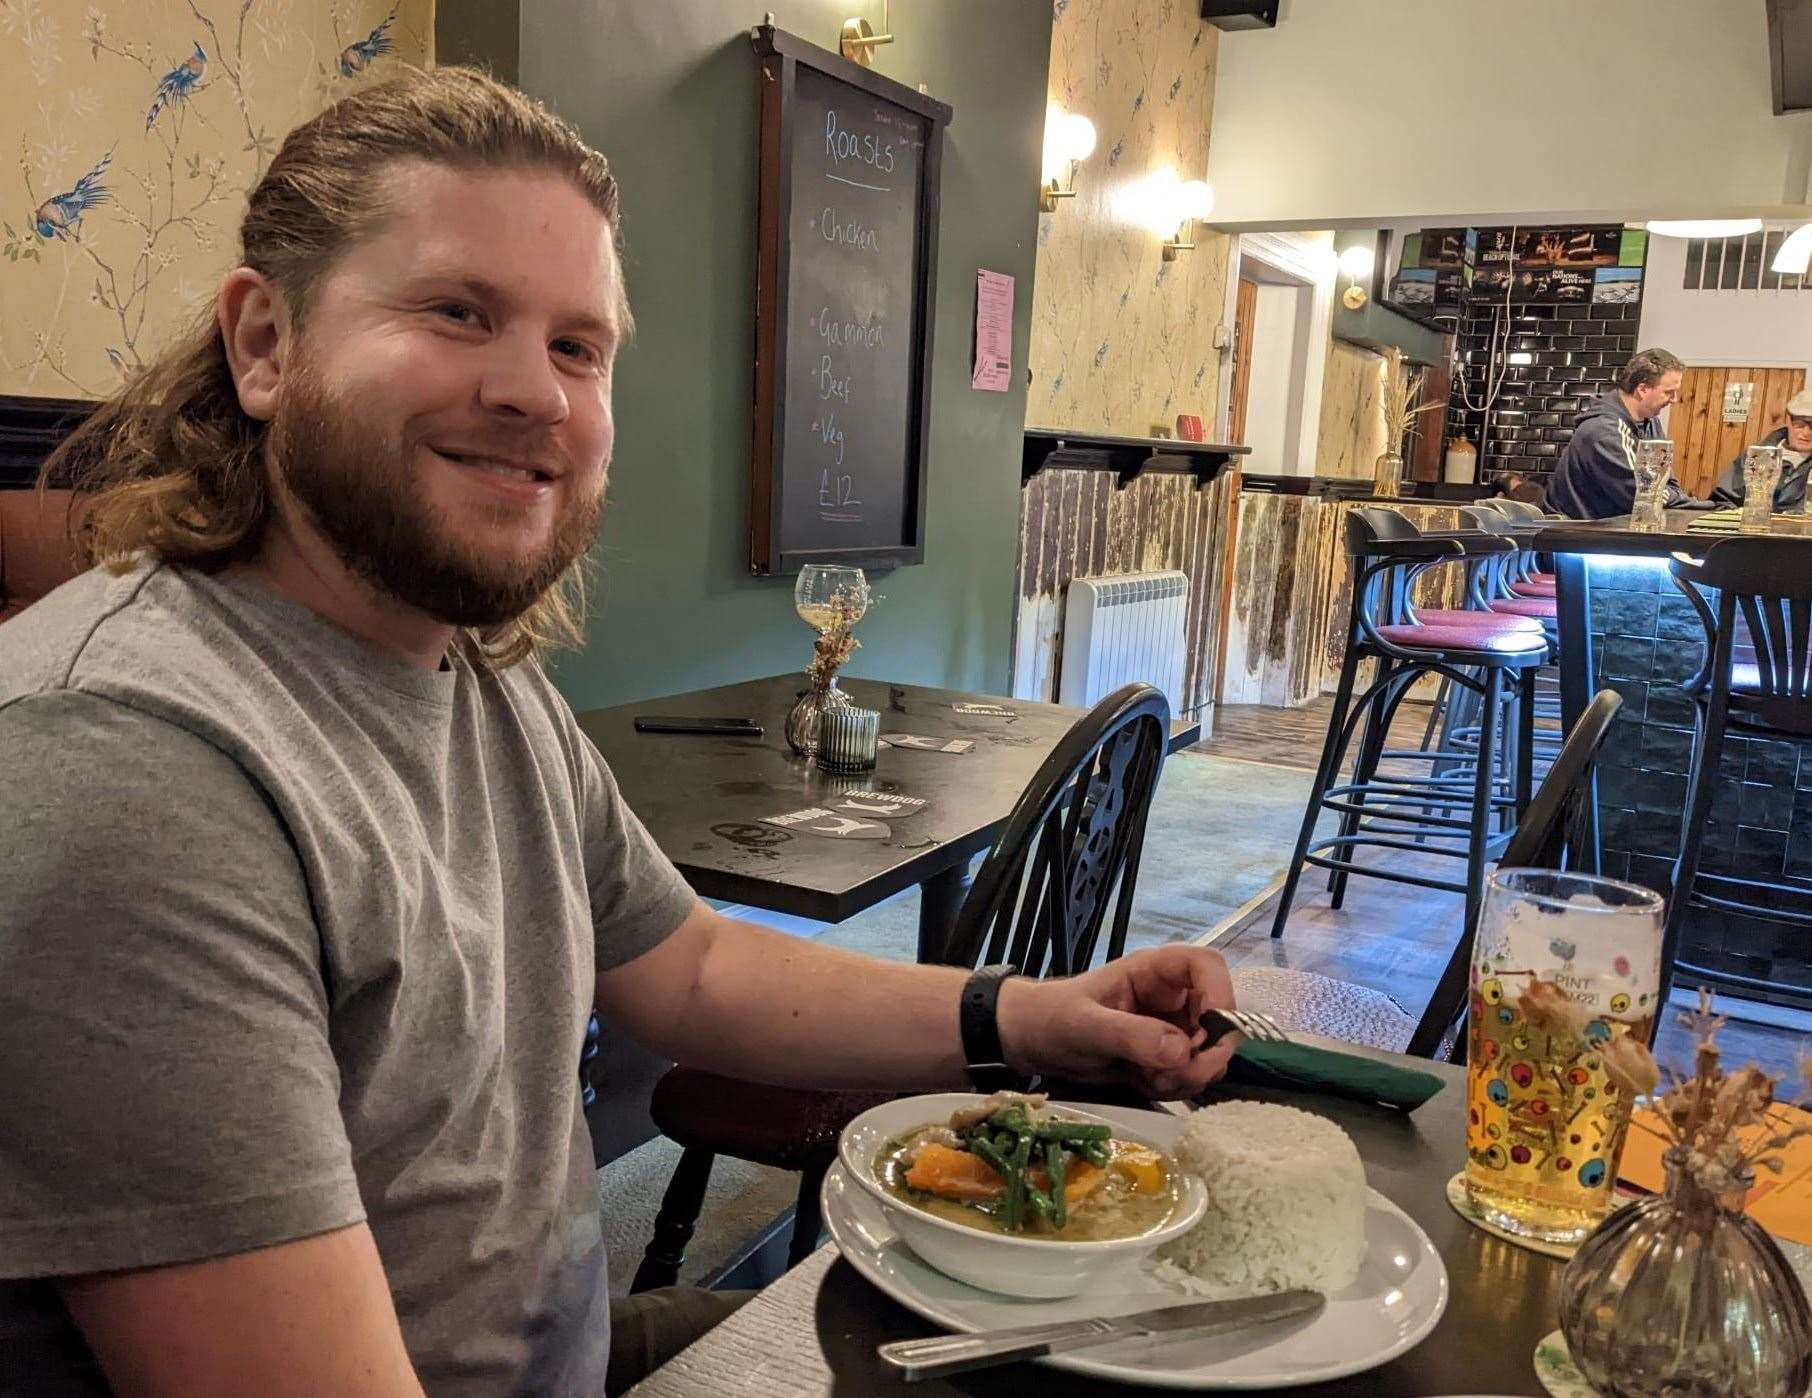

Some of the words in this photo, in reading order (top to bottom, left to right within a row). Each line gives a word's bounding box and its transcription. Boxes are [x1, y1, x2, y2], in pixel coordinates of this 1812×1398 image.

[826, 110, 894, 173] Roasts
[821, 208, 880, 252] Chicken
[820, 355, 852, 403] Beef
[1724, 407, 1747, 415] LADIES
[820, 412, 845, 465] Veg
[818, 468, 862, 507] £12
[844, 789, 927, 805] BREWDOG
[1555, 973, 1591, 990] PINT
